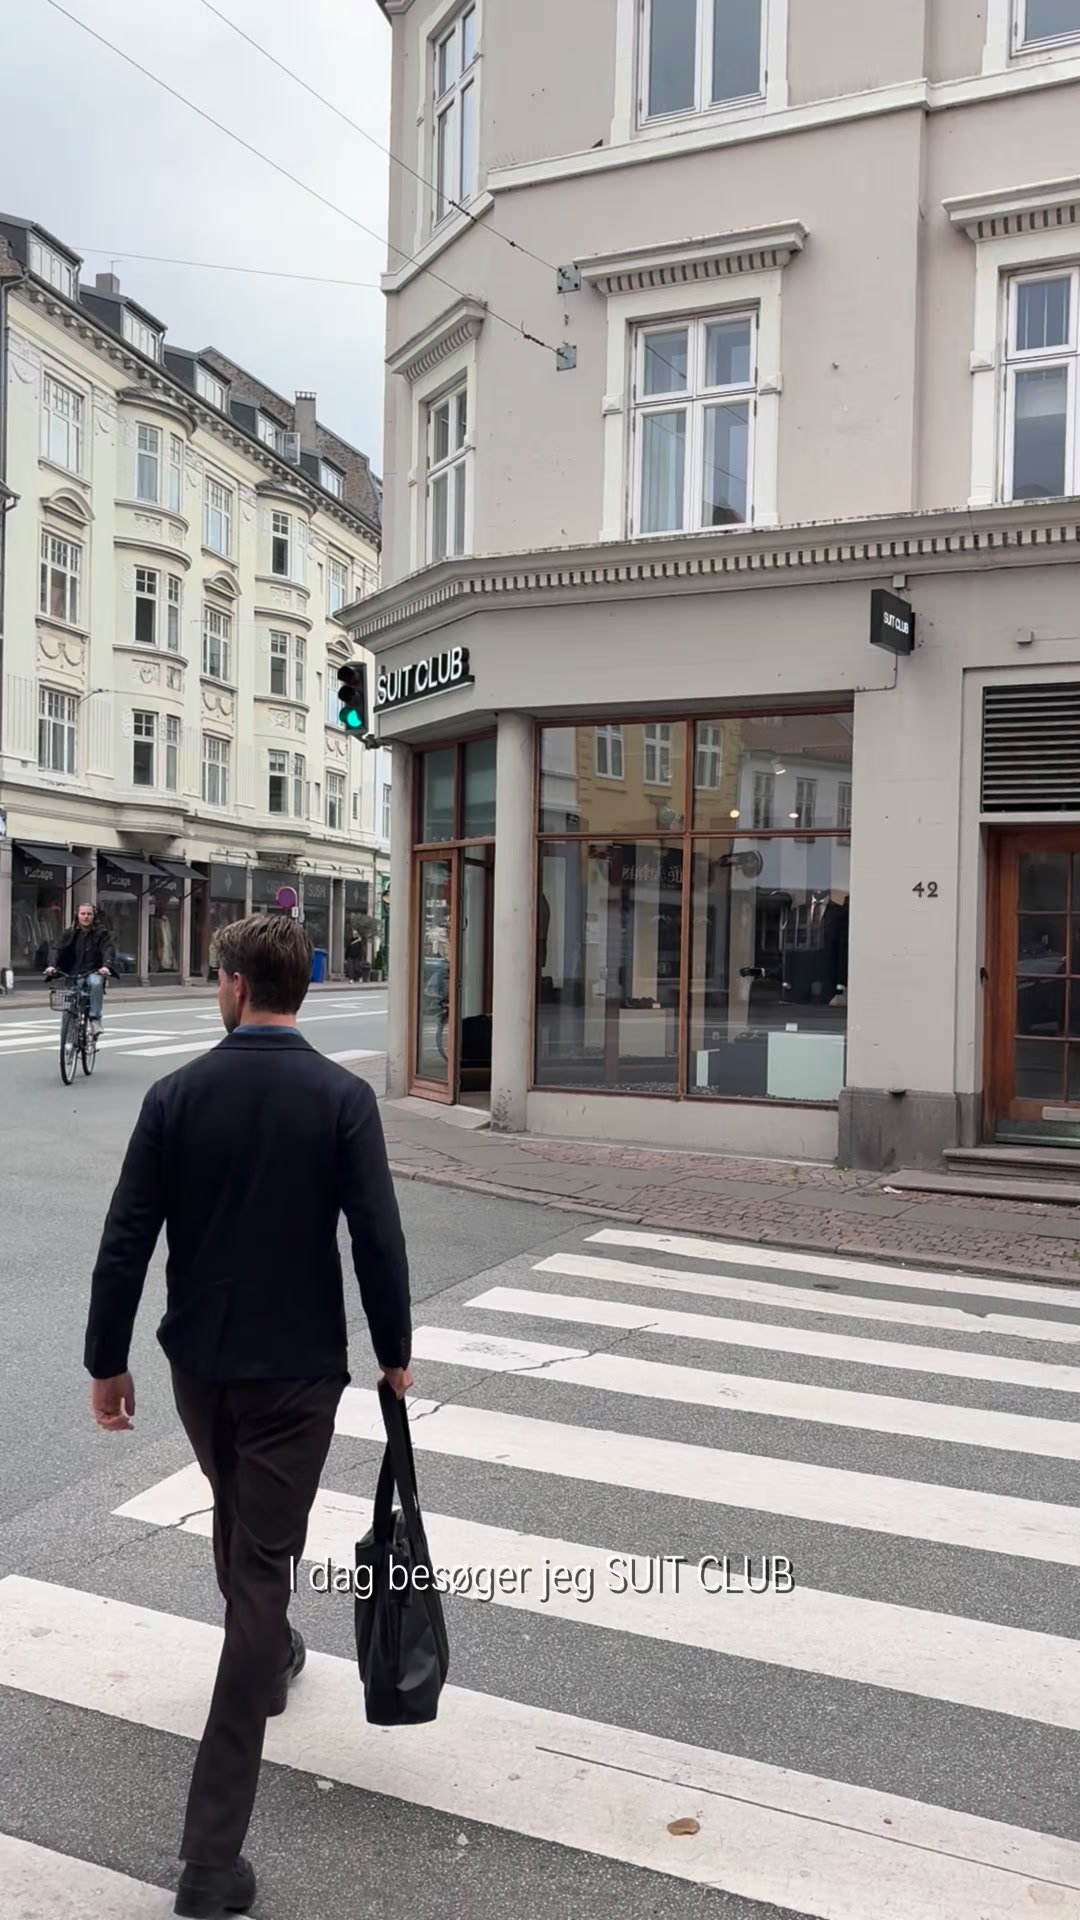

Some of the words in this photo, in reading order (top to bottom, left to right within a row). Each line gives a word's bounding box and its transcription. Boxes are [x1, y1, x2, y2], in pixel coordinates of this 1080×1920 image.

[883, 611, 895, 628] SUIT
[895, 617, 909, 635] CLUB
[377, 664, 412, 705] SUIT
[415, 646, 463, 691] CLUB
[912, 881, 938, 898] 42
